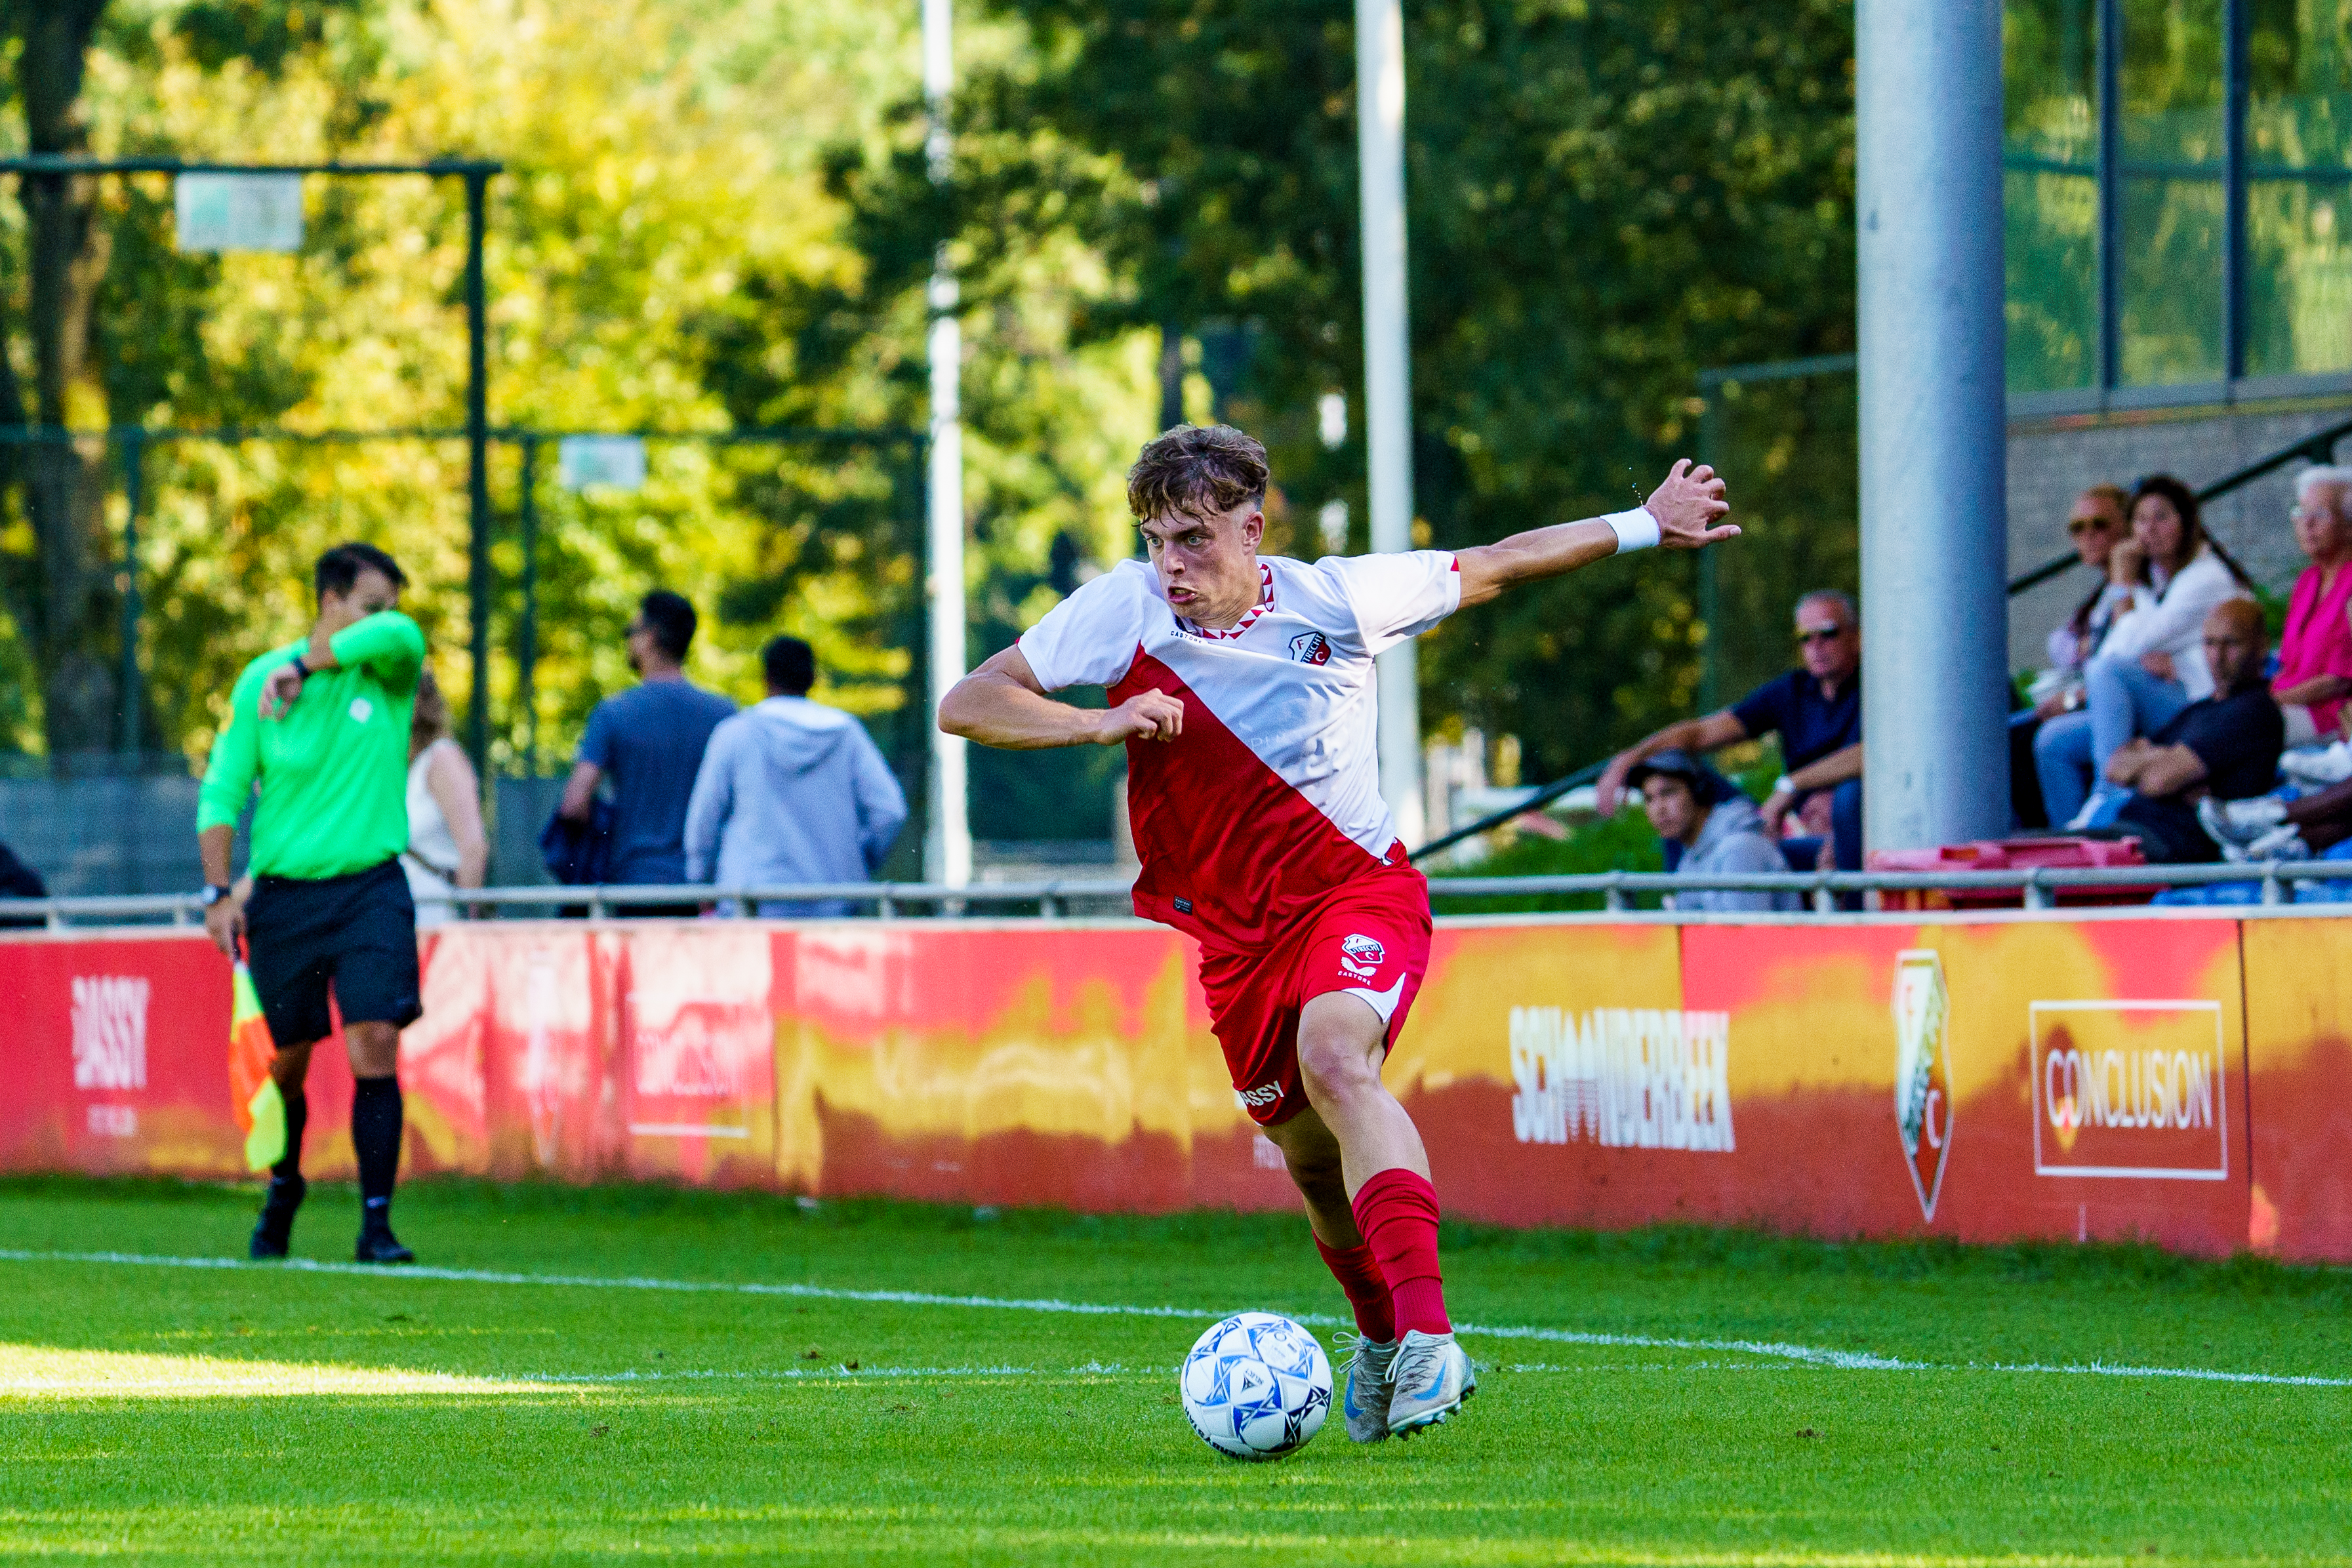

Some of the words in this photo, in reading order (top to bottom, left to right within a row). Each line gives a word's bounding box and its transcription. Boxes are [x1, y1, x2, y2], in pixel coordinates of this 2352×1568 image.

[1170, 630, 1202, 644] CASTORE
[1297, 639, 1305, 651] F
[1301, 633, 1324, 662] TRECHT
[1315, 651, 1325, 662] C
[1348, 944, 1381, 955] UTRECHT
[1365, 951, 1375, 961] C
[1337, 970, 1371, 986] CASTORE
[1238, 1079, 1285, 1107] ASSY
[2045, 1048, 2213, 1129] CONCLUSION
